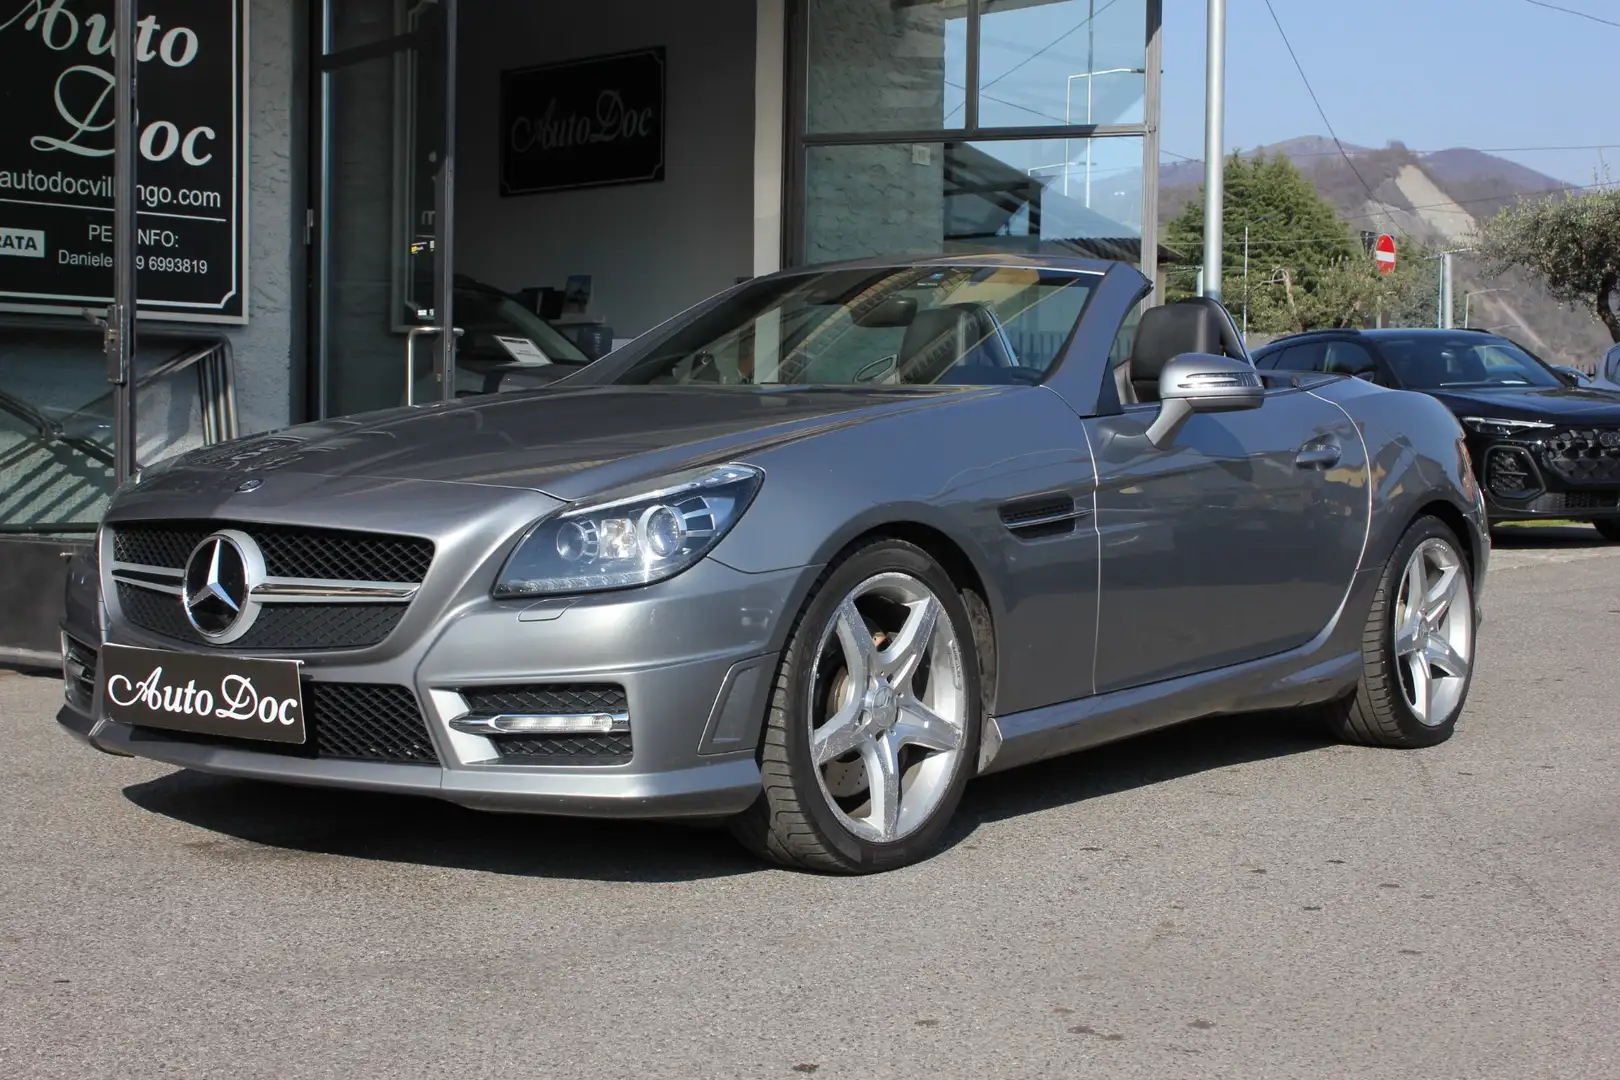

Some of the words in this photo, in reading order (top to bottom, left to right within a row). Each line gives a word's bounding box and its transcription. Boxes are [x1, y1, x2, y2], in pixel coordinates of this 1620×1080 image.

[30, 65, 216, 166] Doc
[511, 97, 590, 154] Auto
[590, 89, 653, 143] Doc
[0, 169, 221, 208] autodocvilngo.com
[88, 224, 114, 243] PE
[136, 228, 179, 248] NFO:
[58, 249, 114, 268] Daniele
[148, 256, 209, 275] 6993819
[108, 666, 214, 716] Auto
[215, 674, 298, 726] Doc
